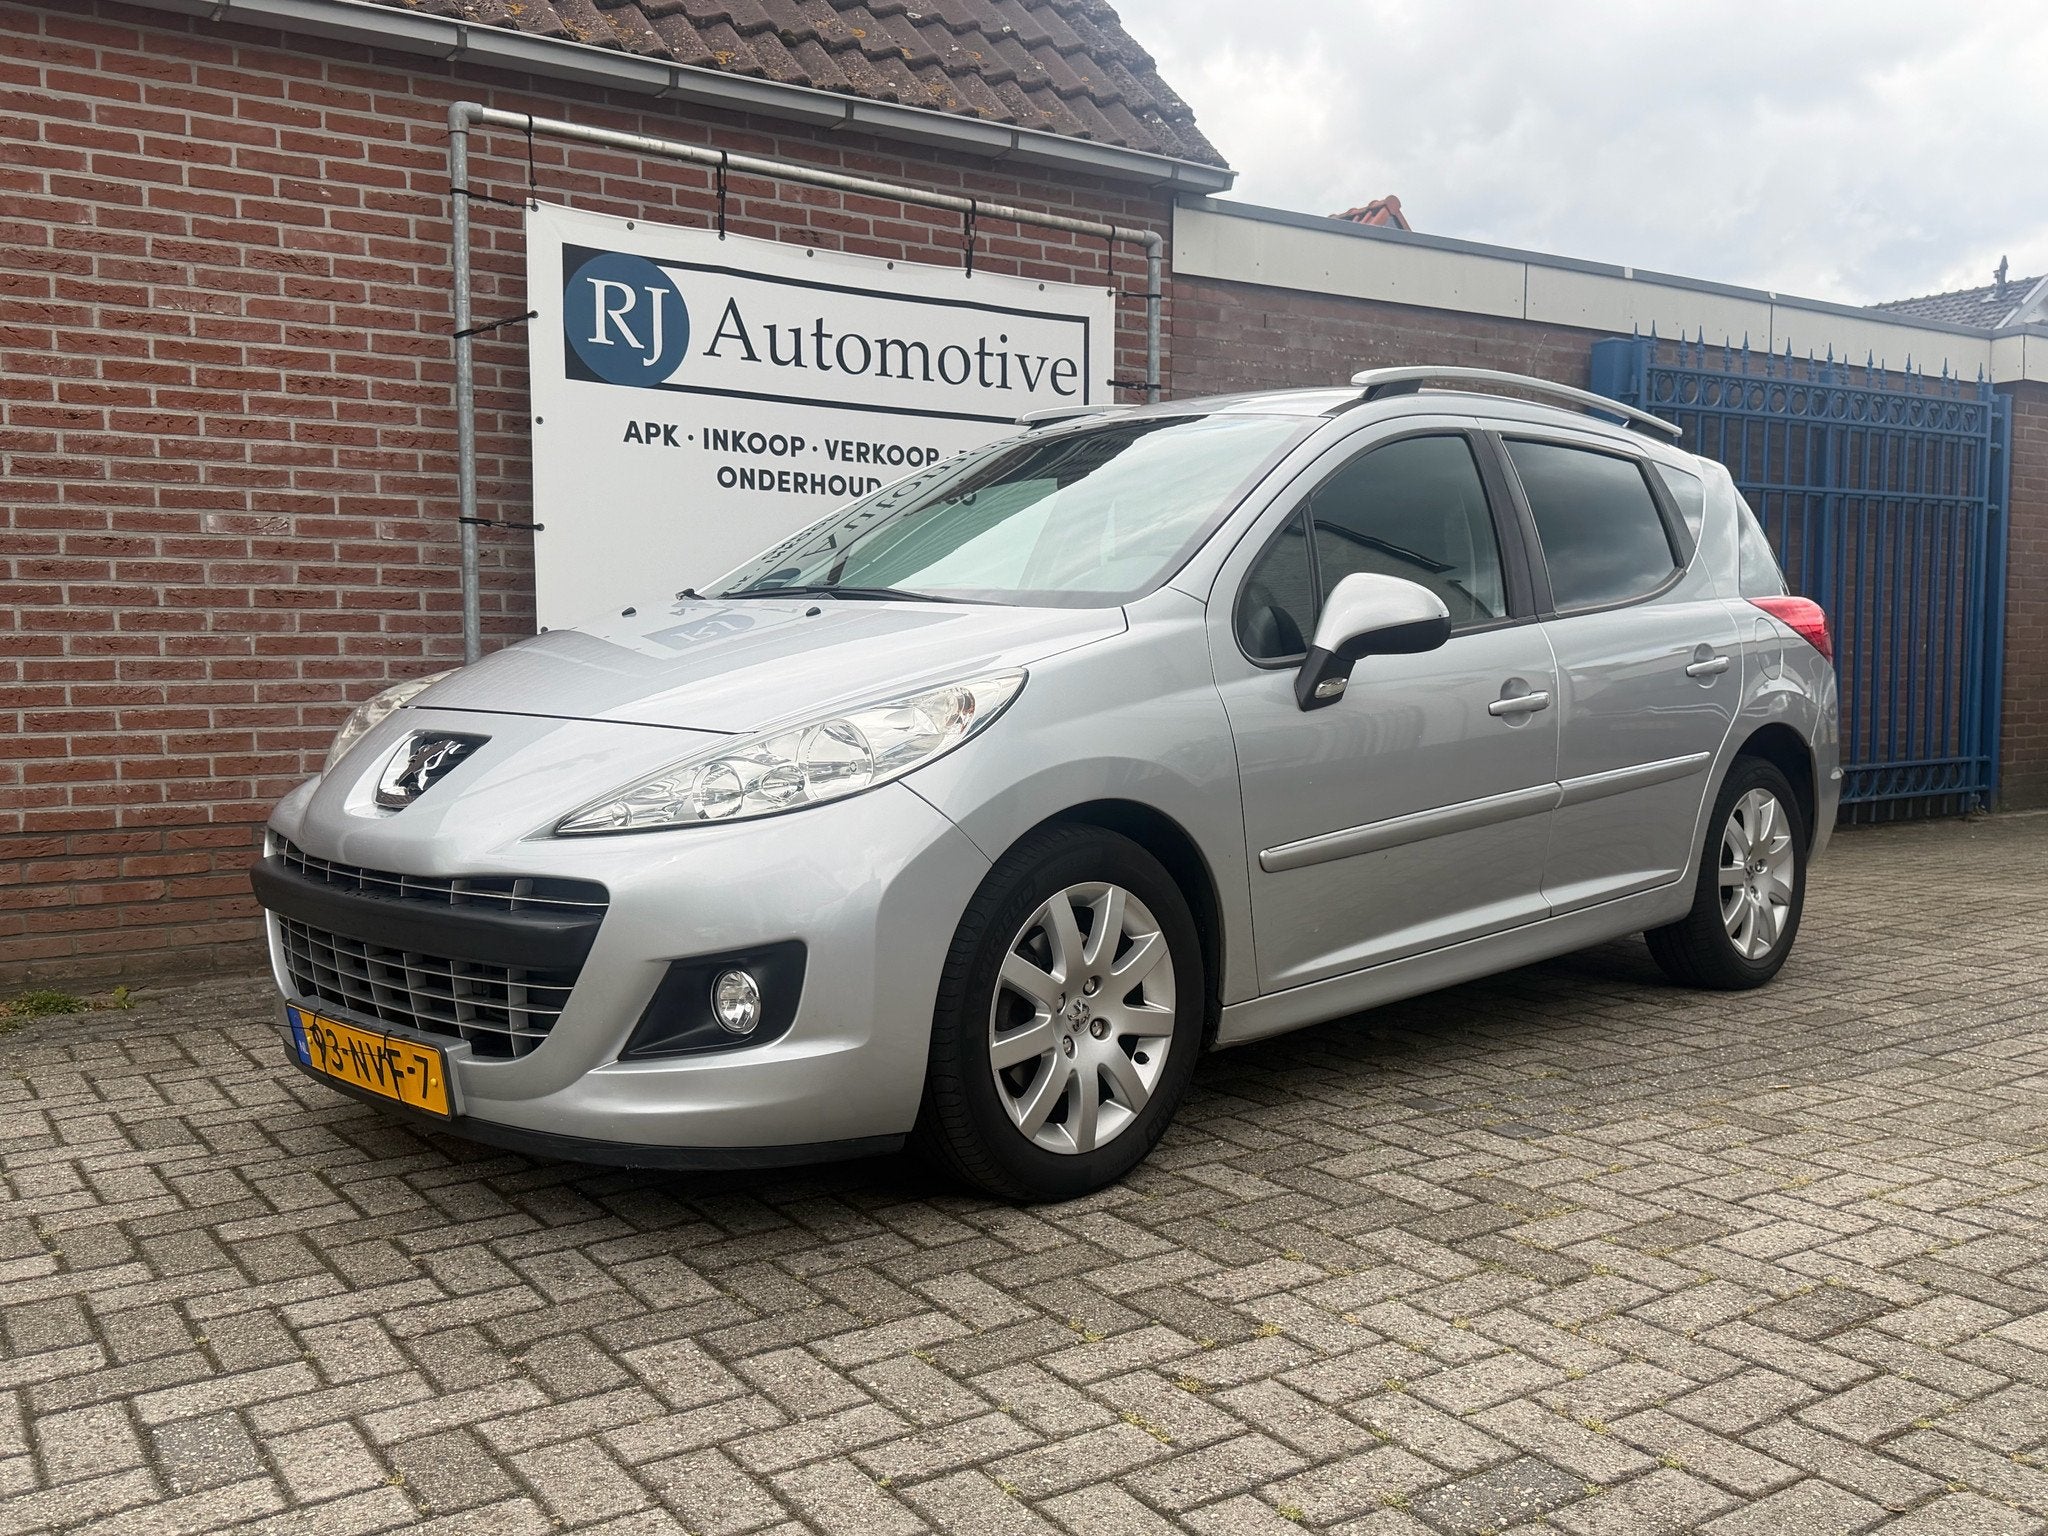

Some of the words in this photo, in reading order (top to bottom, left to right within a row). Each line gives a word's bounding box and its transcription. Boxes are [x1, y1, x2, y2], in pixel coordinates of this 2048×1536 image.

[586, 277, 670, 368] RJ
[702, 297, 1078, 396] Automotive
[623, 420, 681, 448] APK
[703, 427, 806, 458] INKOOP
[824, 438, 940, 468] VERKOOP
[716, 465, 882, 498] ONDERHOUD
